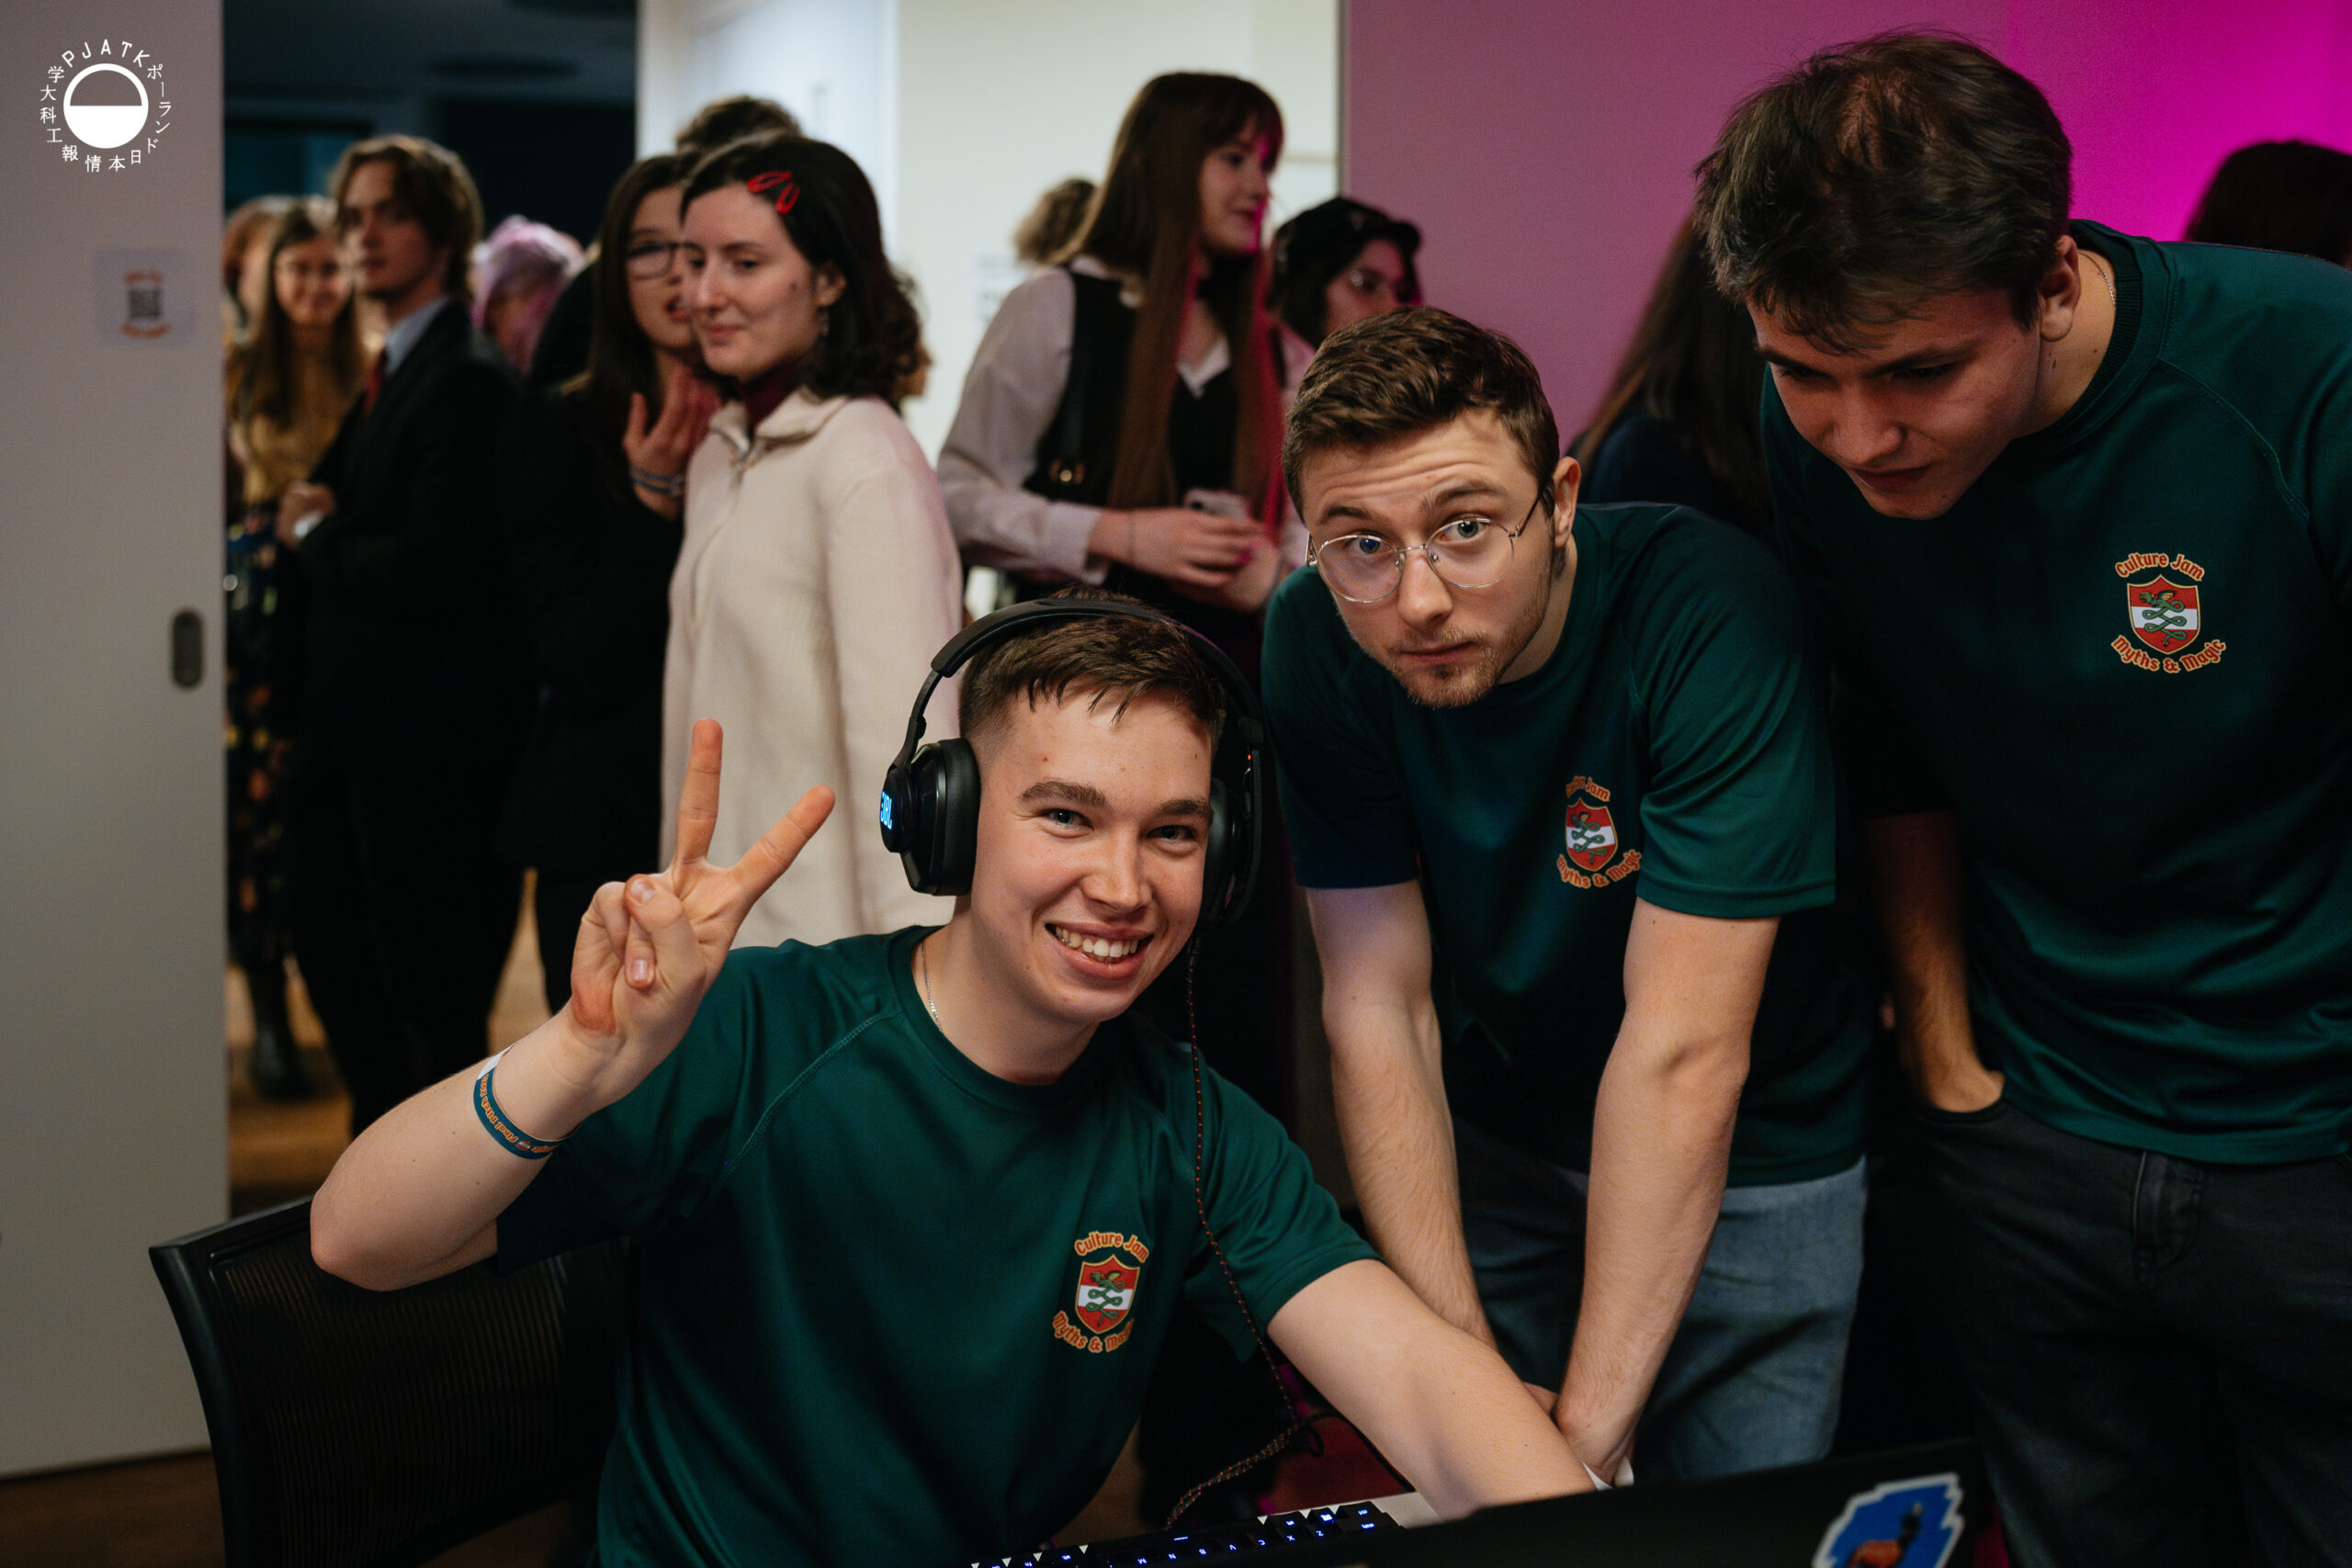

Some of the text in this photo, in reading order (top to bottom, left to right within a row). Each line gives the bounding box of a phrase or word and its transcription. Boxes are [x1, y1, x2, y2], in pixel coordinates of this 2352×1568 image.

[2115, 552, 2205, 581] Culture Jam
[2110, 635, 2226, 673] Myths & Magic
[880, 791, 893, 830] JBL
[1606, 849, 1642, 882] Magic
[1074, 1231, 1149, 1263] Culture Jam
[1052, 1310, 1088, 1349] Myths
[1088, 1337, 1102, 1353] &
